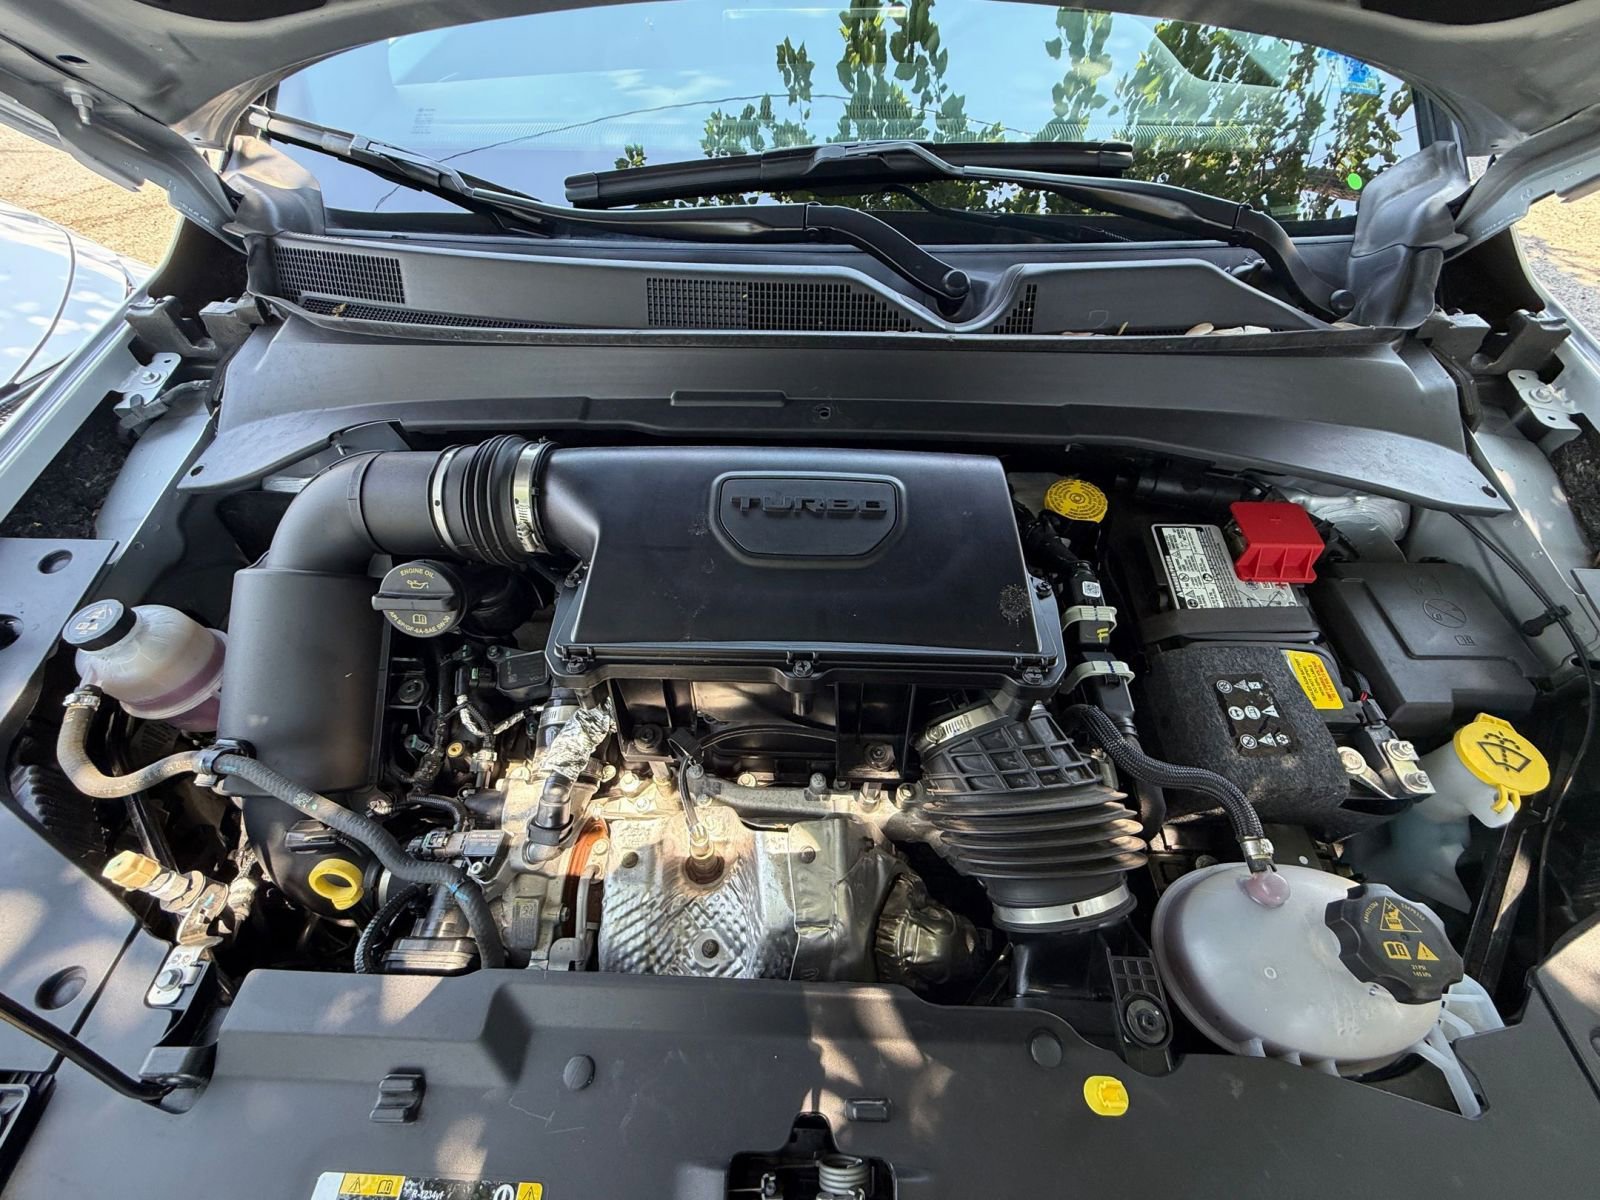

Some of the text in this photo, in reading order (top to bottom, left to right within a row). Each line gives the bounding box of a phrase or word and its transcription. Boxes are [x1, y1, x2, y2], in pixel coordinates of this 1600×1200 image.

[731, 496, 887, 515] TURBO
[400, 568, 435, 579] ENGINE OIL
[389, 612, 399, 621] API
